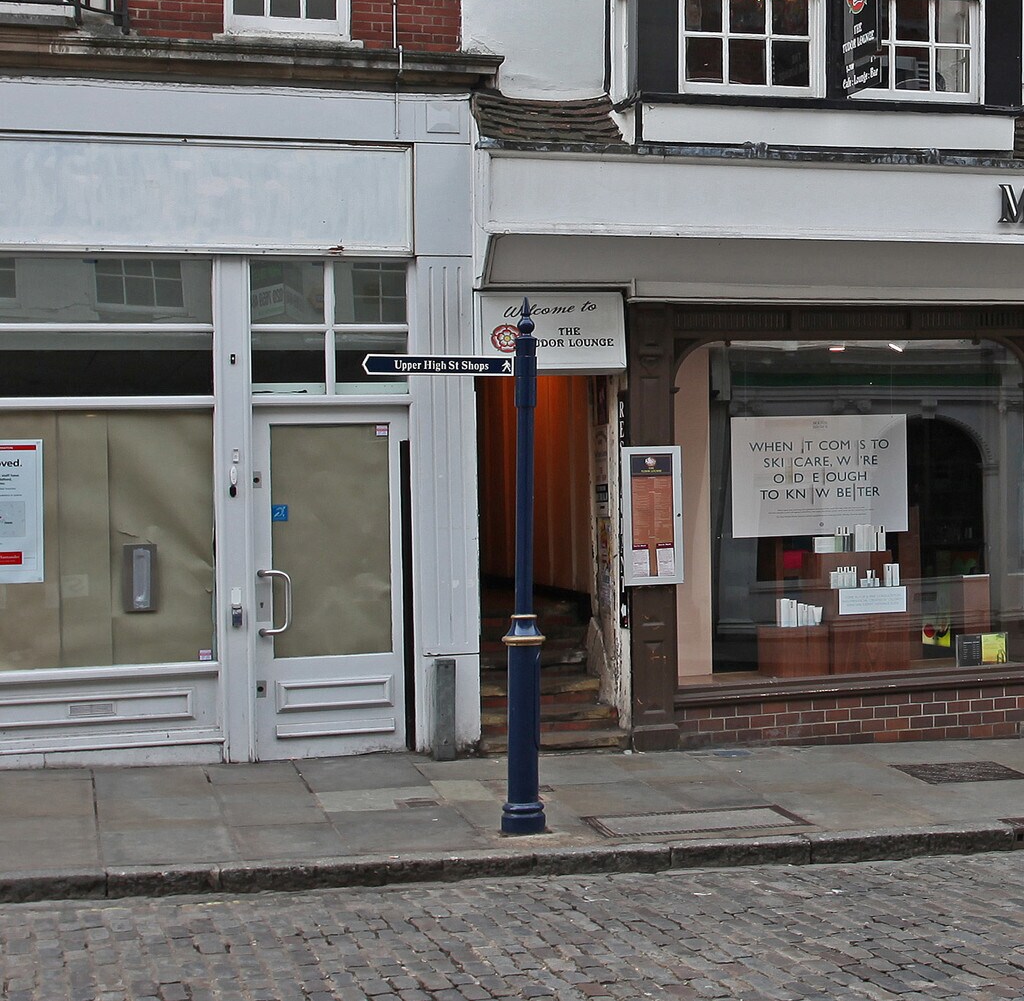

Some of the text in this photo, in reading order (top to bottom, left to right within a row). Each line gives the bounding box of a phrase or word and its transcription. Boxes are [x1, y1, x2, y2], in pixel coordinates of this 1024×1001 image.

[503, 300, 597, 319] Wlcome to
[558, 327, 581, 336] THE
[535, 337, 615, 348] UDOR LOUNGE
[394, 360, 490, 371] Upper High St Shops
[749, 441, 793, 452] WHEN
[871, 438, 890, 450] TO
[0, 459, 23, 468] ved.
[760, 489, 780, 500] TO
